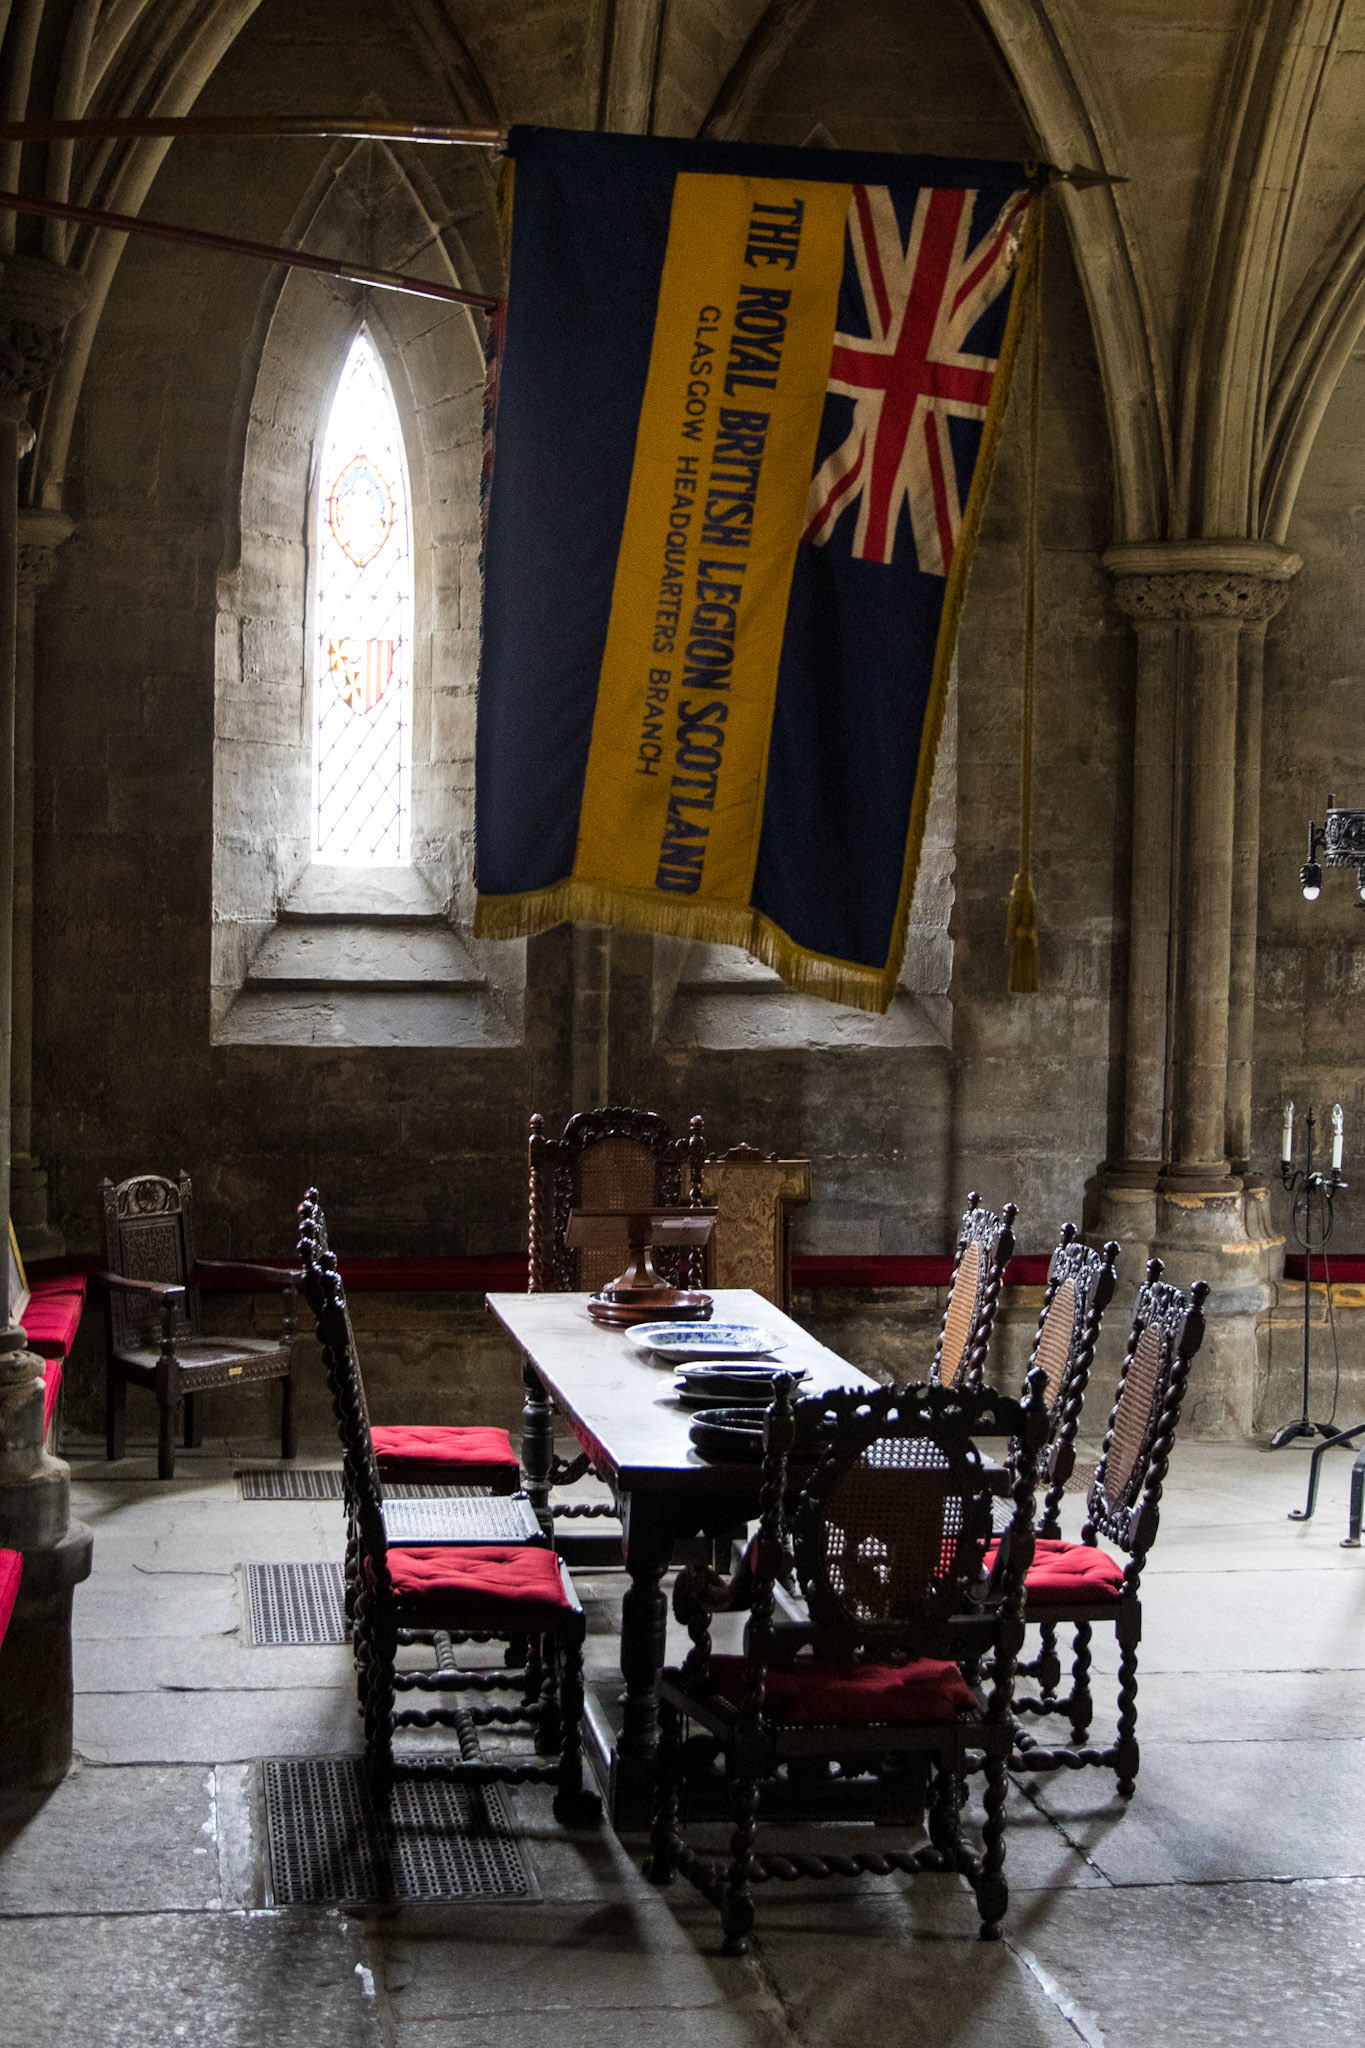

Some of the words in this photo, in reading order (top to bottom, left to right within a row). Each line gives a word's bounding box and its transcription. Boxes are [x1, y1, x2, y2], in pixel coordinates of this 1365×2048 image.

[743, 199, 805, 271] THE
[682, 306, 721, 441] GLASGOW
[723, 286, 792, 397] ROYAL
[701, 408, 771, 548] BRITISH
[653, 456, 699, 653] HEADQUARTERS
[681, 560, 747, 691] LEGION
[637, 668, 671, 777] BRANCH
[654, 701, 729, 893] SCOTLAND
